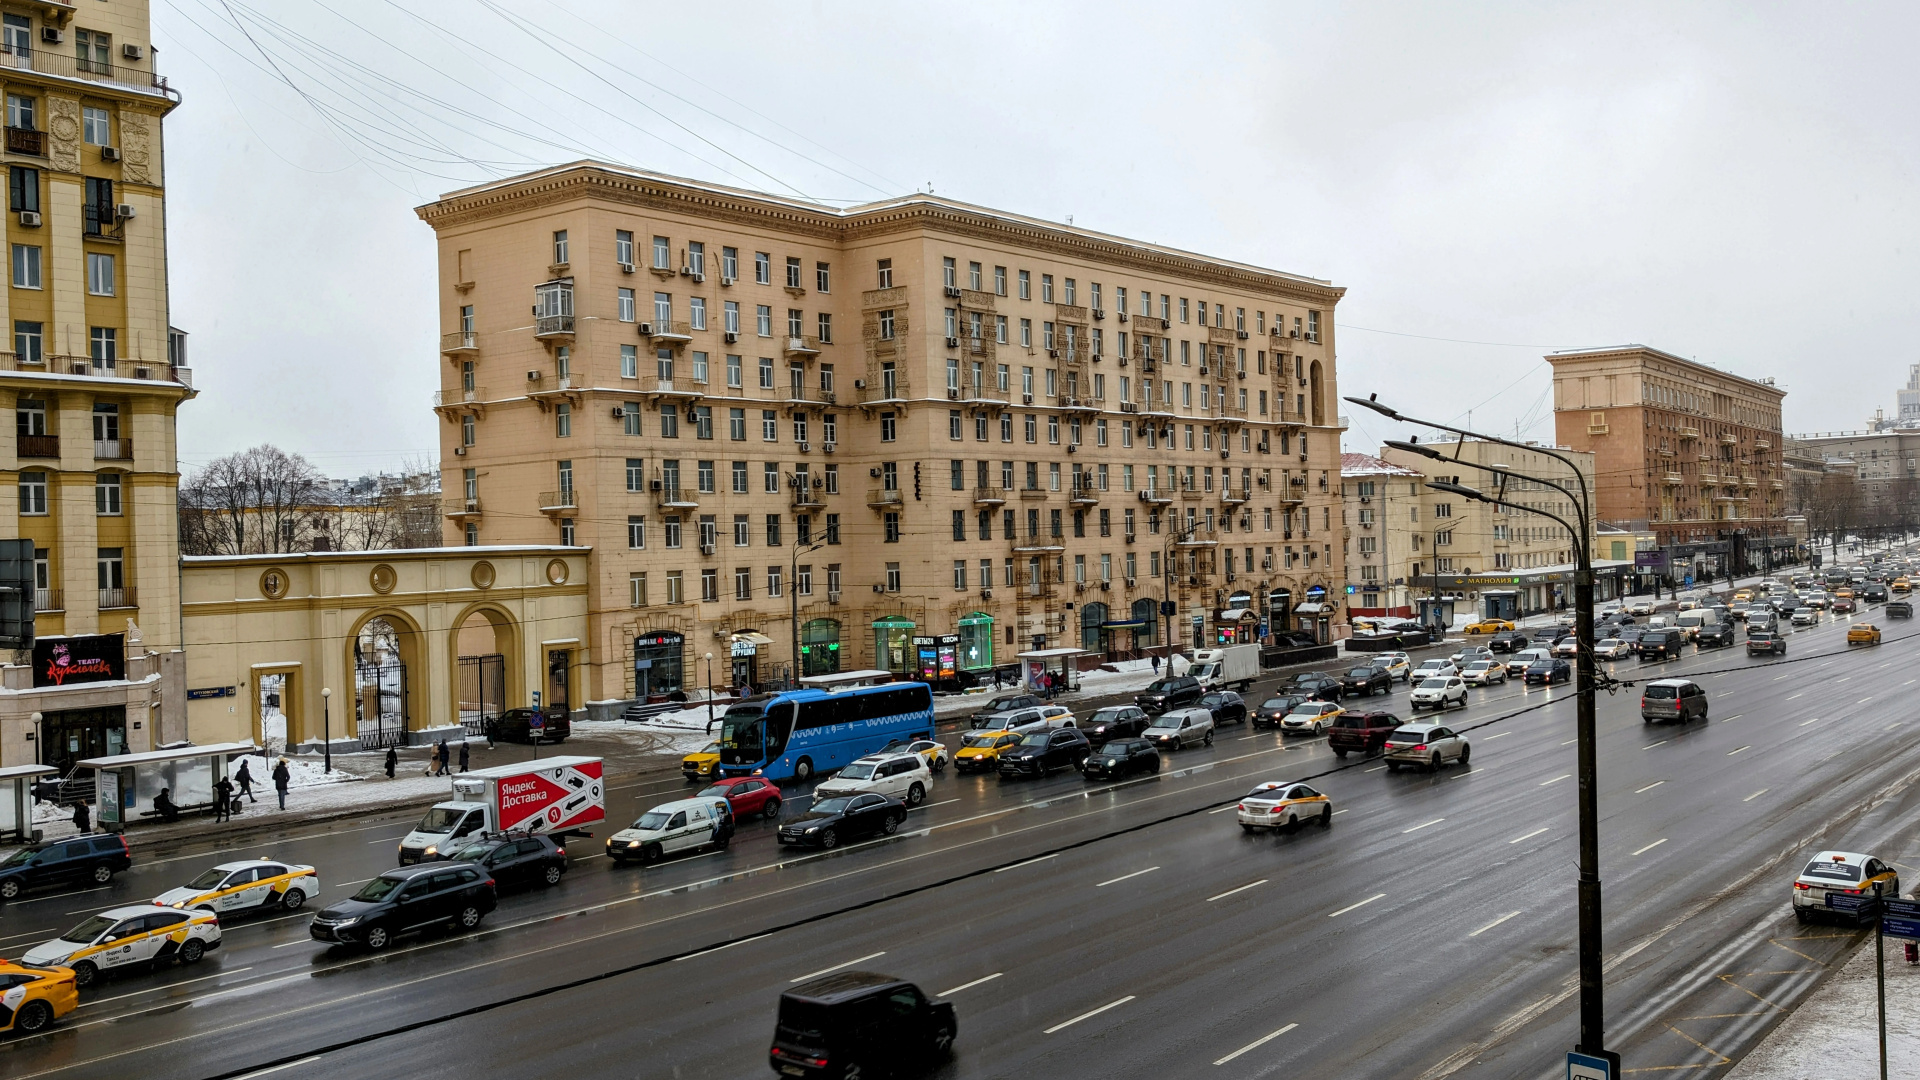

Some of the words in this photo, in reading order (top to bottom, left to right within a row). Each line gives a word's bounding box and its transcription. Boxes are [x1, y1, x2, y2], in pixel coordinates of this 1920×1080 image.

[942, 636, 959, 644] OZON
[731, 648, 756, 657] ИГРУШКИ
[502, 781, 536, 795] Яндекс
[503, 791, 547, 809] Доставка
[105, 948, 122, 956] Яндекс
